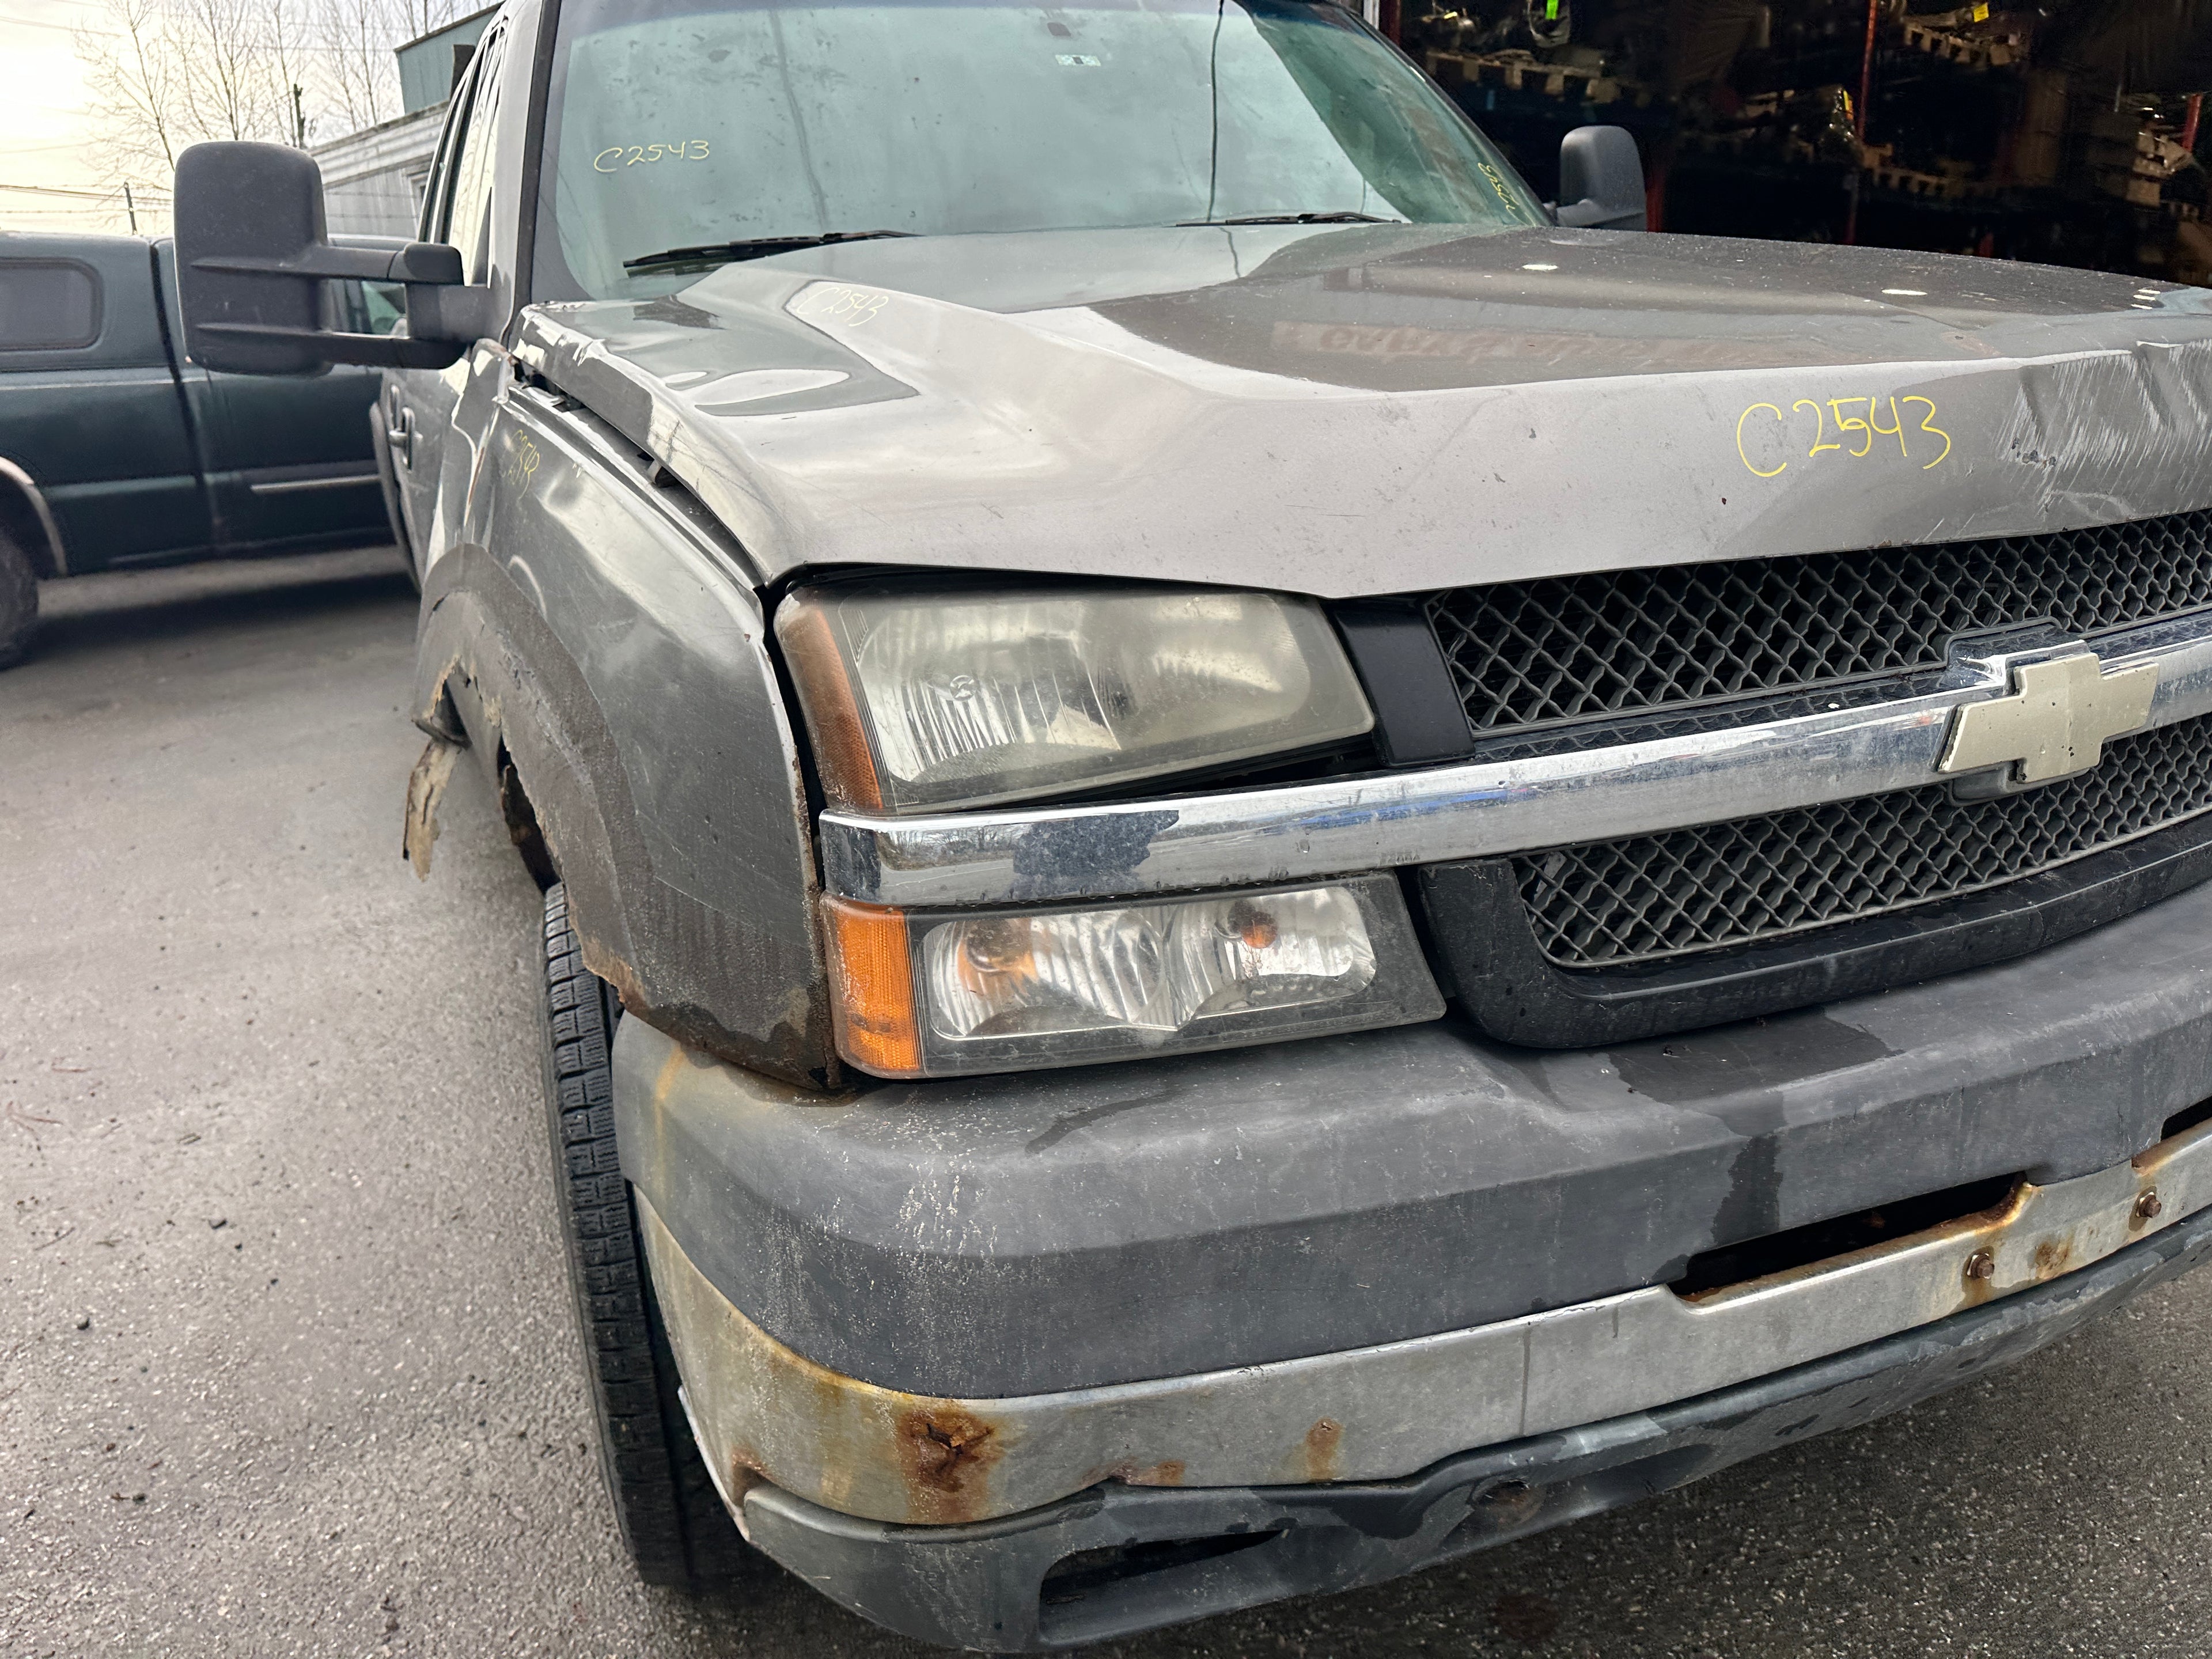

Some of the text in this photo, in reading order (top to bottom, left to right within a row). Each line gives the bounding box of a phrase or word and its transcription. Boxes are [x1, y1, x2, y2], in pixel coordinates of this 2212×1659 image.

[594, 140, 710, 173] C2543
[797, 288, 889, 327] C2543
[1737, 396, 1951, 477] C2543
